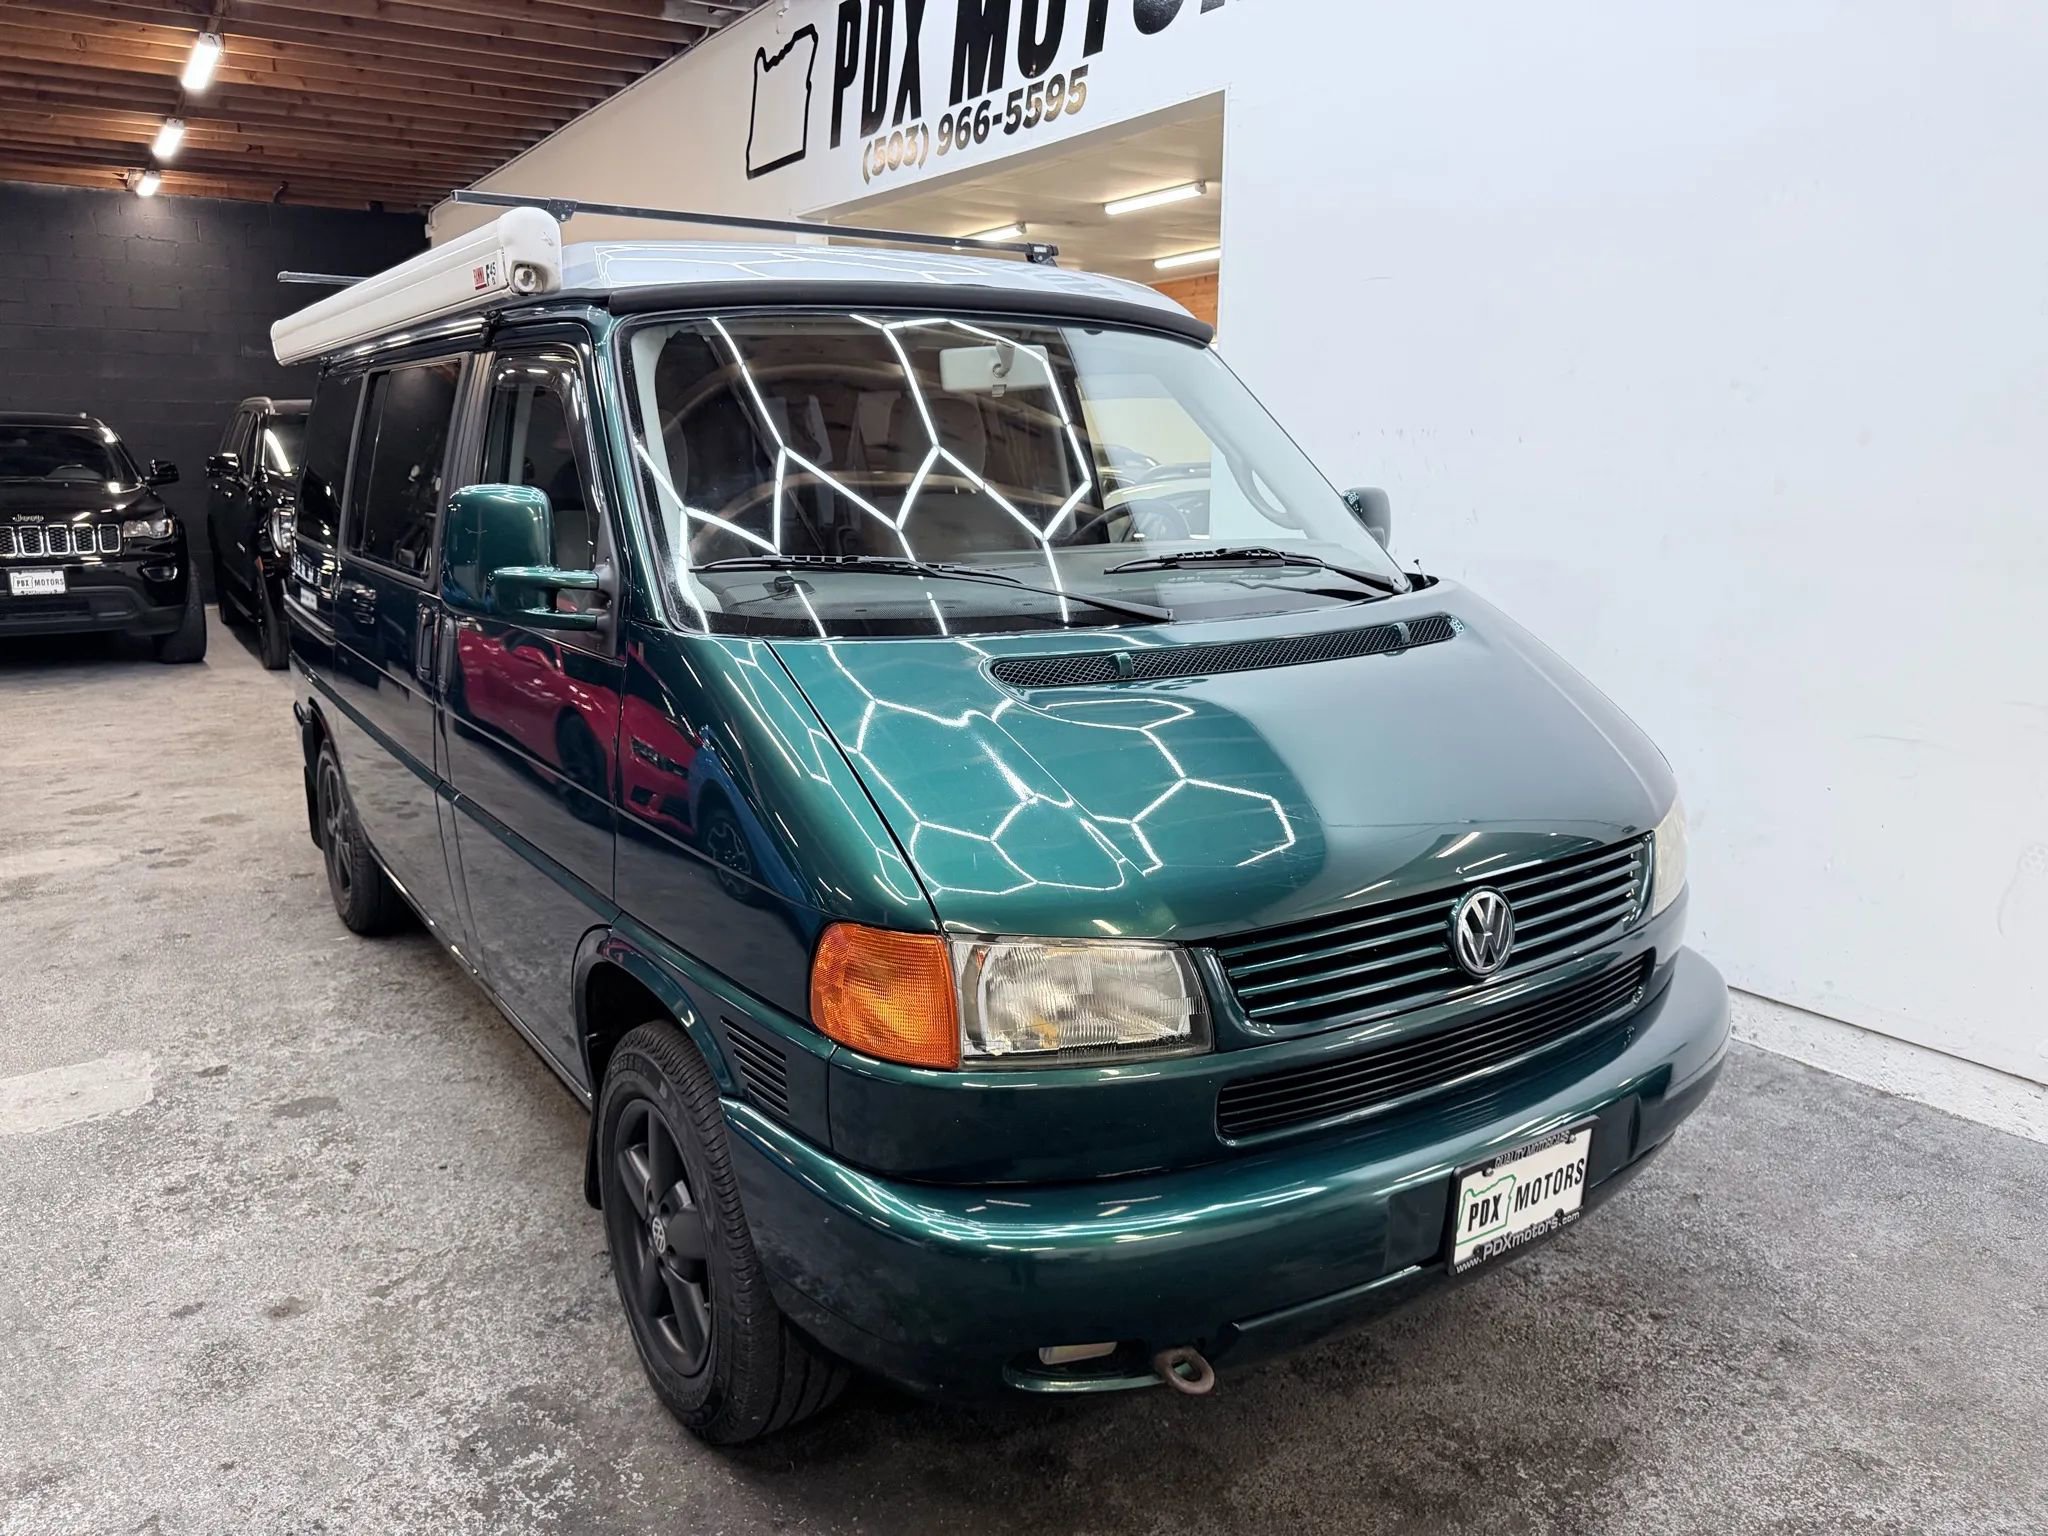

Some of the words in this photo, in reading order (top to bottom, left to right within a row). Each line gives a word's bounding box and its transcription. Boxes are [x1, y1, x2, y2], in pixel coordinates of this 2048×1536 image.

[830, 0, 926, 149] PDX
[862, 122, 929, 184] (503)
[937, 64, 1088, 156] 966-5595
[34, 578, 65, 587] MOTORS
[1467, 1192, 1502, 1232] PDX
[1513, 1158, 1585, 1213] MOTORS
[1456, 1211, 1580, 1274] www.PDXmotors.com
